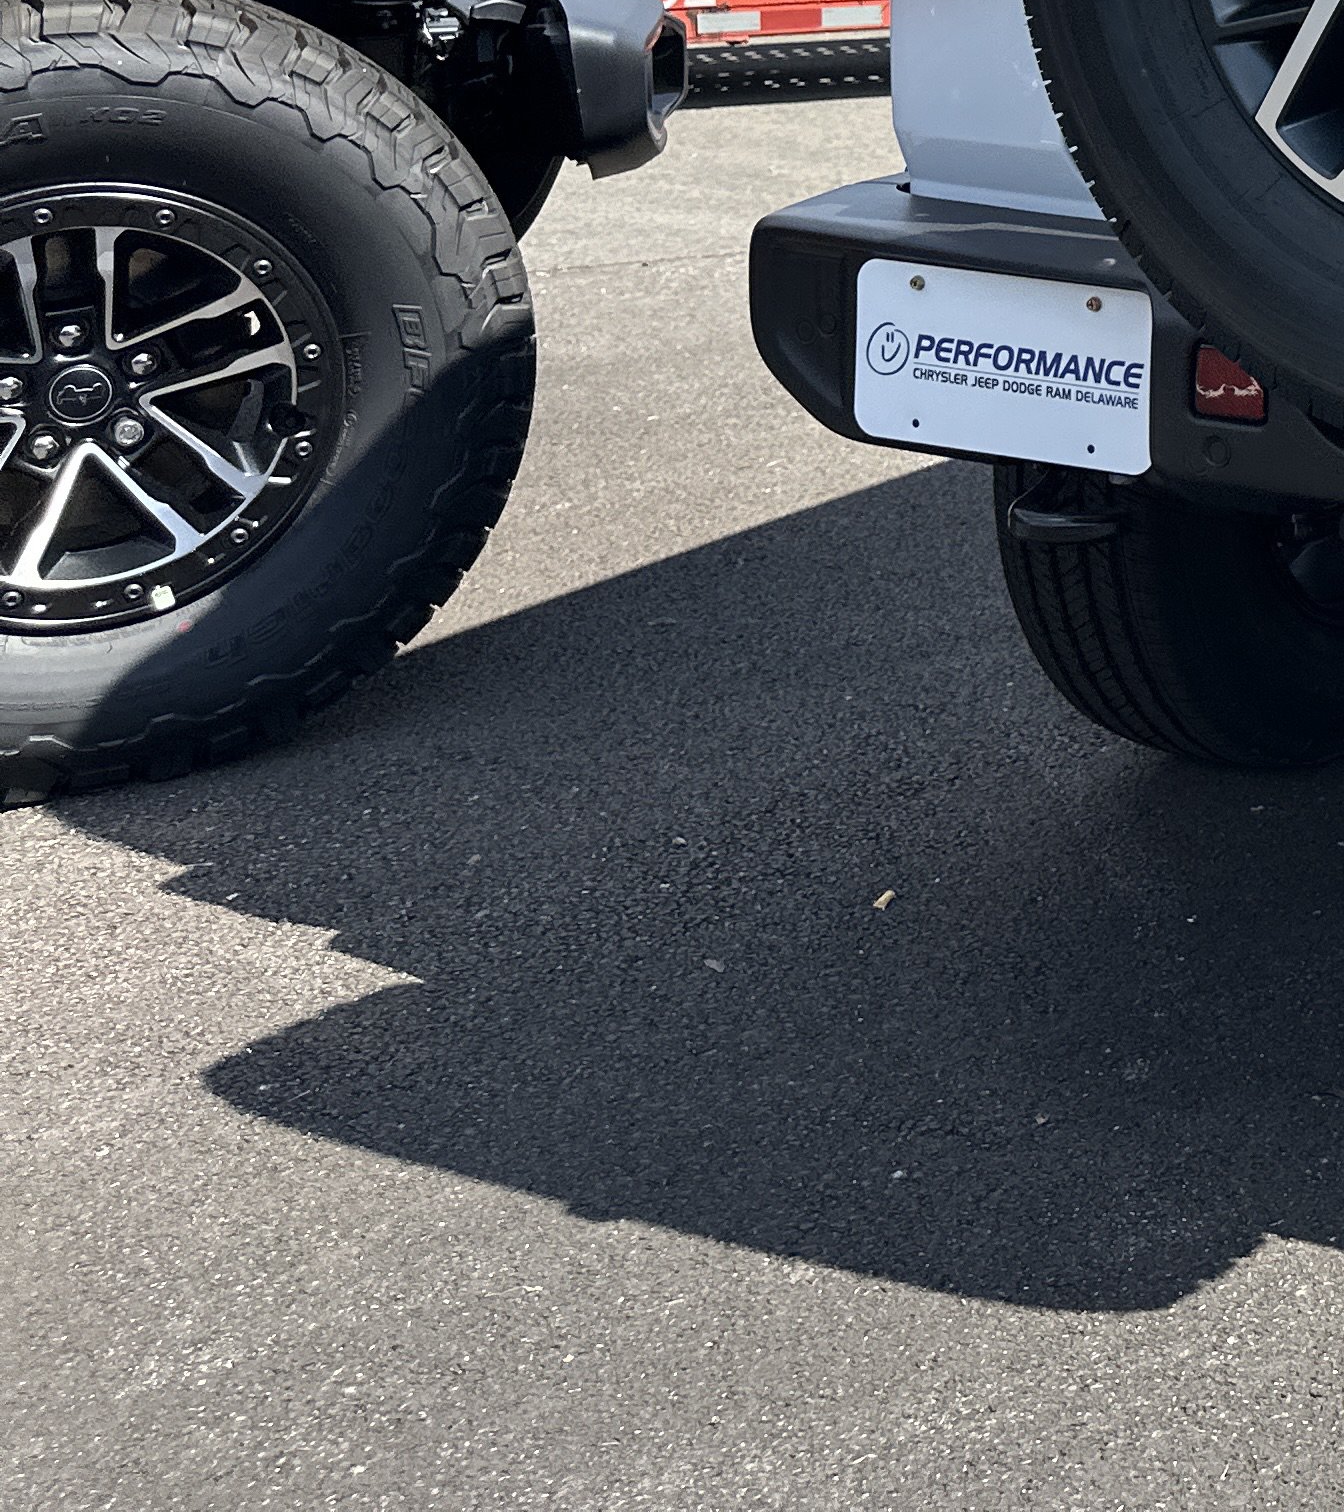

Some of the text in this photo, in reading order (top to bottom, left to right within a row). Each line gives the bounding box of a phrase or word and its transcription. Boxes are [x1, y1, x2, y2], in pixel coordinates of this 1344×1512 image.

[913, 333, 1145, 389] PERFORMANCE
[912, 367, 1139, 410] CHRYSLER JEEP DODGE RAM DELAWARE
